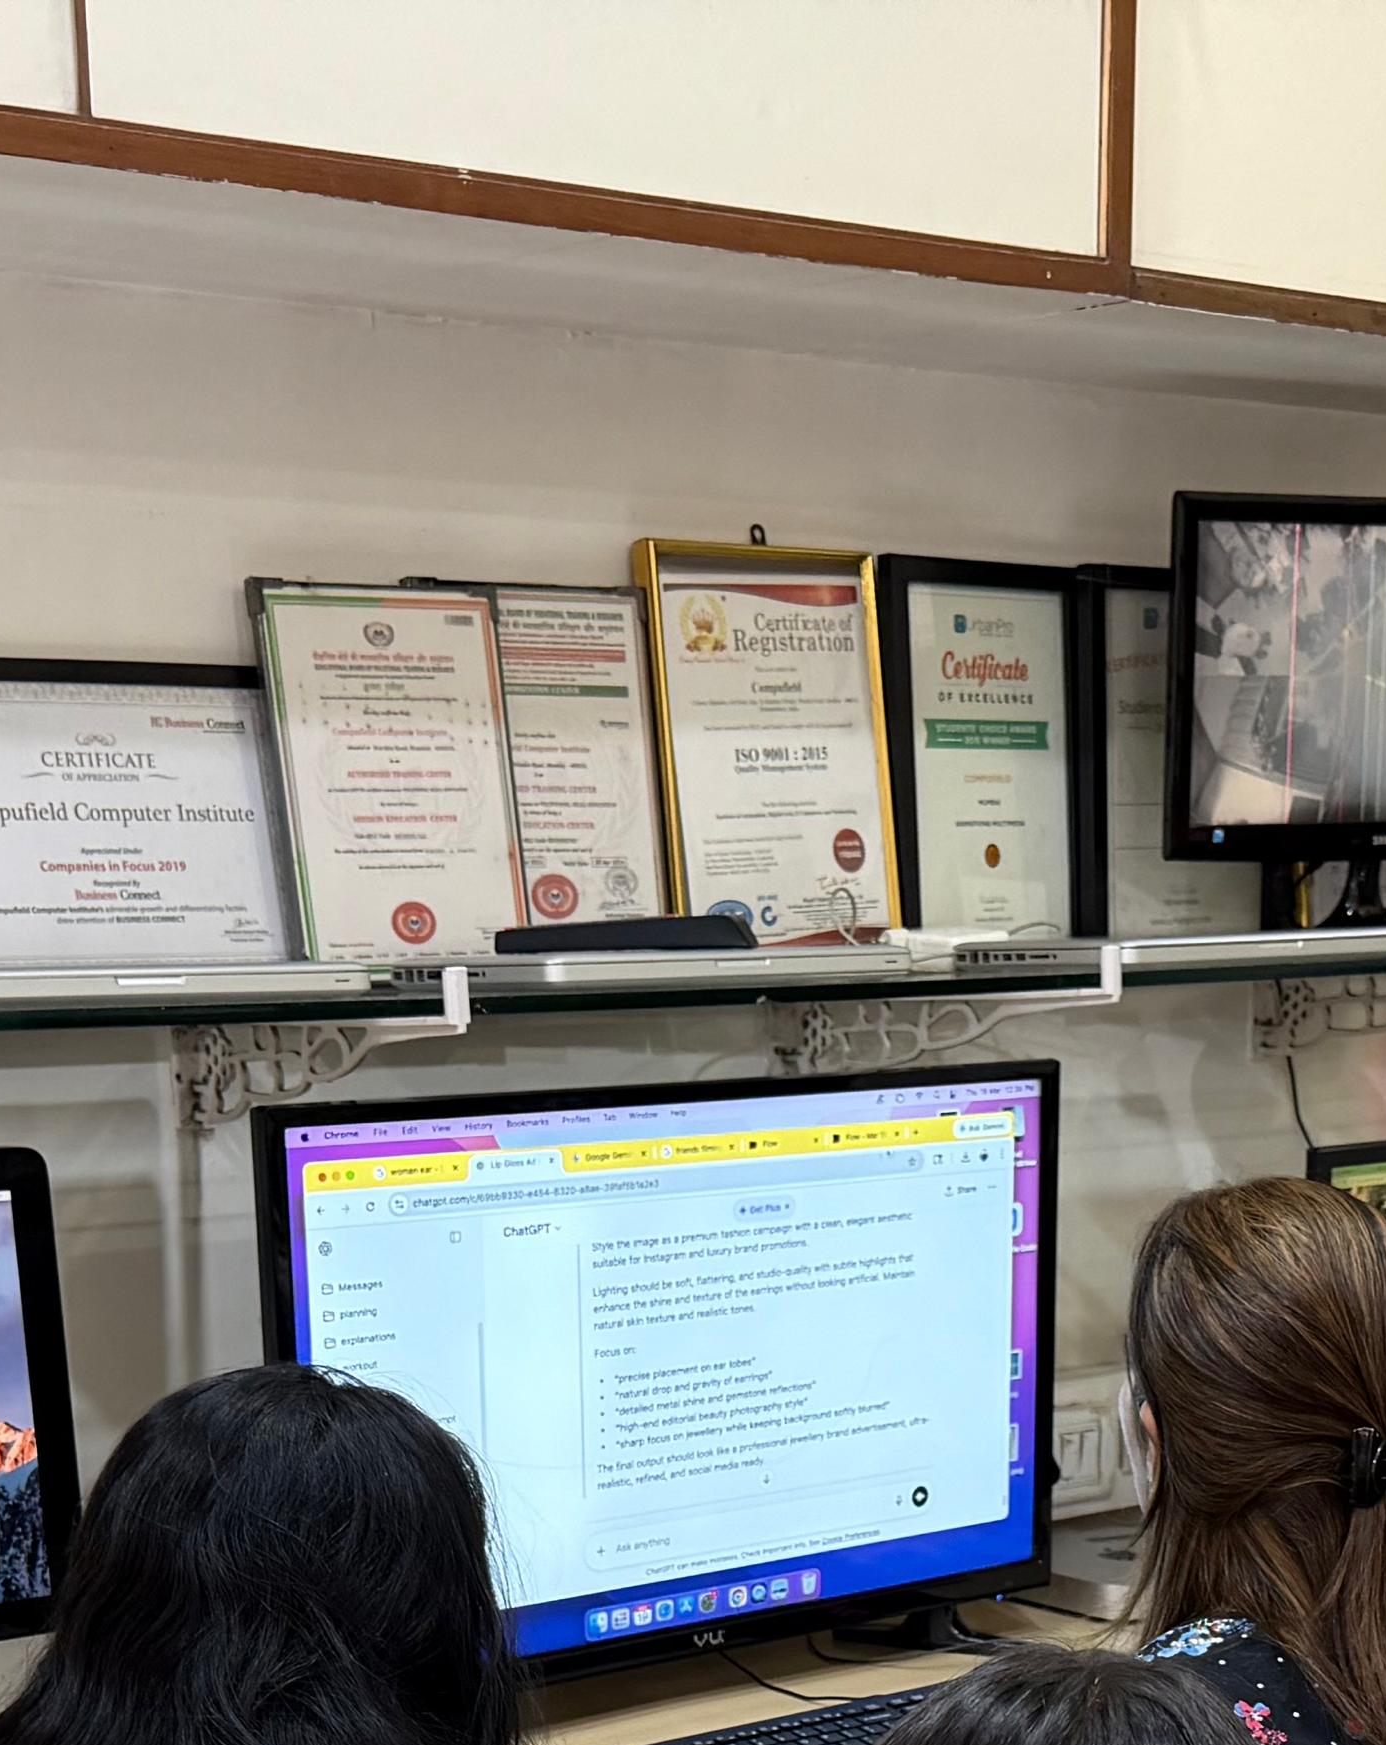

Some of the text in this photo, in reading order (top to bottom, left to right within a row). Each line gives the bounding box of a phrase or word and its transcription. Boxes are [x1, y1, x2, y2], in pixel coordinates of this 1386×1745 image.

[754, 613, 853, 632] Certificate of
[733, 629, 854, 657] Registration
[942, 650, 1029, 687] Certificate
[960, 693, 1033, 704] EXCELLENCE
[41, 752, 155, 768] CERTIFICATE
[735, 748, 760, 763] ISO
[74, 803, 171, 827] Computer
[177, 804, 254, 822] Institute
[40, 860, 186, 875] Companies in Focus 2019
[119, 889, 161, 900] Connect
[324, 1131, 359, 1140] Chrome
[503, 1224, 551, 1238] ChatGPT
[592, 1242, 614, 1253] Style
[617, 1241, 630, 1249] the
[593, 1257, 626, 1268] suitable
[629, 1255, 641, 1264] for
[644, 1253, 686, 1263] Instagram
[689, 1248, 704, 1258] and
[734, 1243, 758, 1254] brand
[338, 1280, 383, 1292] Messages
[593, 1287, 628, 1298] Lighting
[631, 1281, 659, 1293] should
[662, 1280, 672, 1290] be
[739, 1272, 754, 1281] and
[593, 1303, 630, 1313] enhance
[633, 1301, 647, 1309] the
[675, 1295, 690, 1304] and
[693, 1293, 722, 1302] texture
[735, 1290, 748, 1298] the
[340, 1307, 378, 1320] planning
[594, 1308, 728, 1330] natural skin texture and realistic
[341, 1332, 396, 1346] explanations
[594, 1349, 620, 1358] Focus
[653, 1366, 698, 1380] placement
[652, 1386, 672, 1395] drop
[675, 1382, 690, 1392] and
[693, 1379, 721, 1391] gravity
[657, 1400, 680, 1410] metal
[662, 1403, 782, 1426] editorial beauty photography
[647, 1435, 670, 1444] focus
[686, 1427, 723, 1439] jewellery
[749, 1419, 781, 1429] keeping
[597, 1464, 614, 1473] The
[637, 1456, 664, 1468] output
[667, 1452, 694, 1463] should
[697, 1449, 713, 1459] look
[670, 1468, 685, 1479] and
[688, 1467, 711, 1475] social
[616, 1538, 670, 1552] Ask anything
